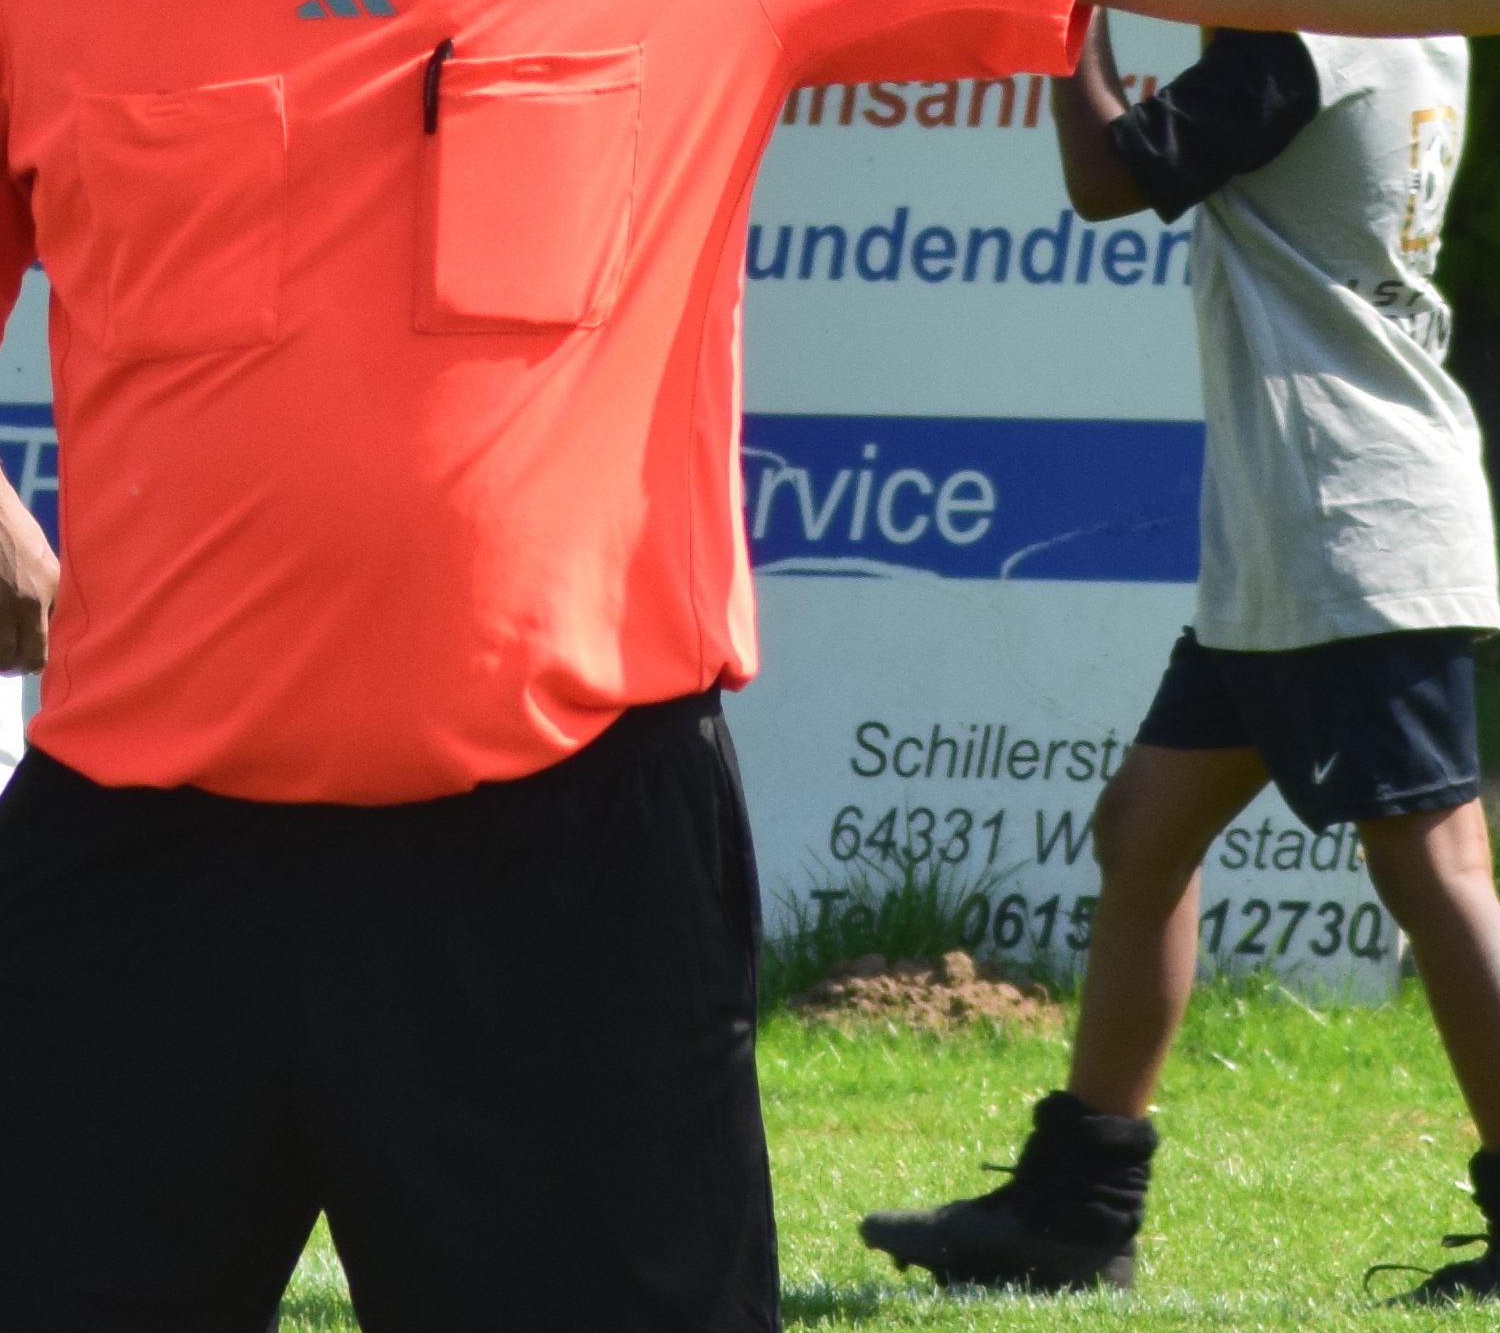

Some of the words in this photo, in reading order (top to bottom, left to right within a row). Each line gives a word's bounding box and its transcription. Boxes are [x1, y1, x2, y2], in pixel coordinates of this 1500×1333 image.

[745, 205, 1192, 286] undendien
[745, 443, 995, 545] rvice
[850, 720, 1134, 782] Schillerst
[829, 804, 1005, 865] 64331
[958, 891, 1099, 951] 0615
